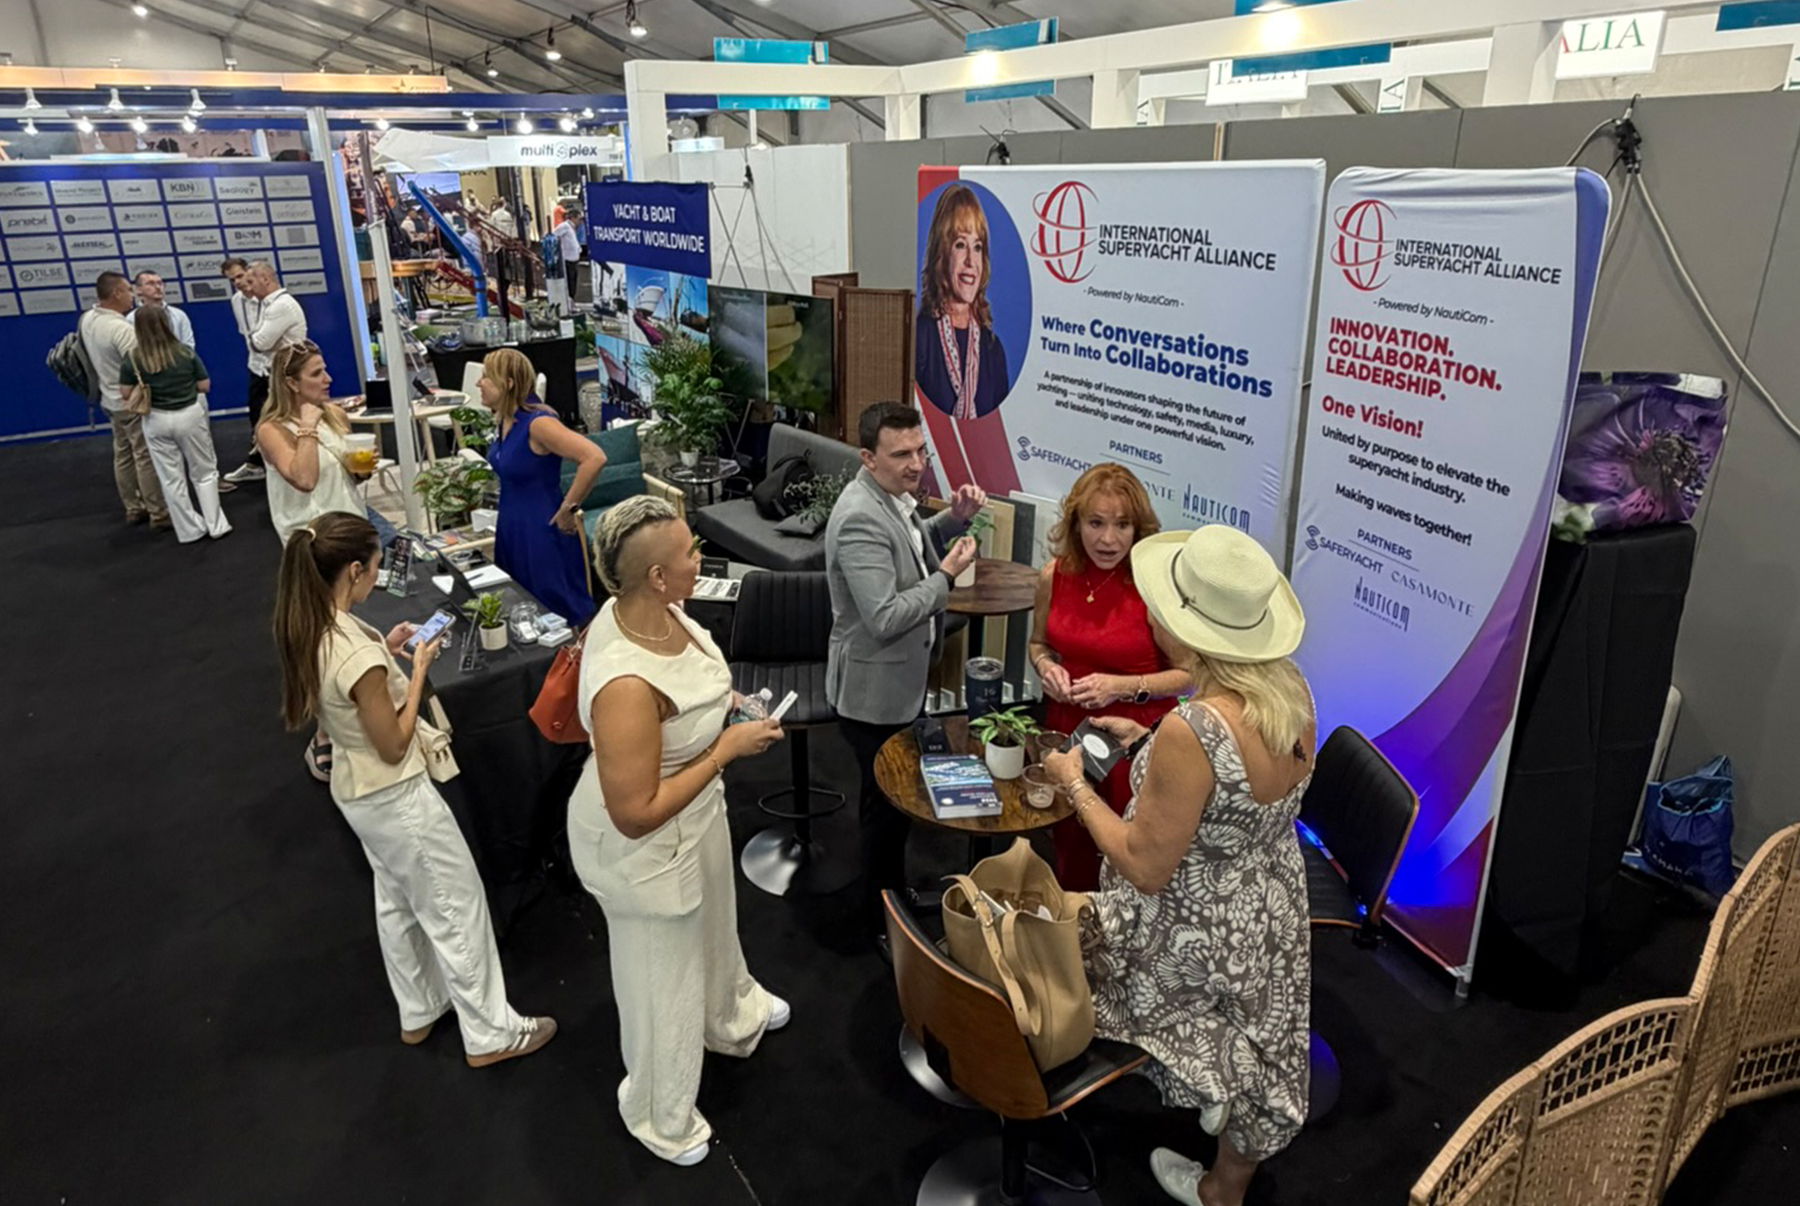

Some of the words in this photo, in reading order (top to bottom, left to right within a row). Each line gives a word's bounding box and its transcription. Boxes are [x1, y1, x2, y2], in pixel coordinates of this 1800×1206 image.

[520, 144, 554, 157] multi
[568, 145, 598, 159] plex
[612, 204, 641, 220] YACHT
[642, 205, 649, 221] &
[650, 206, 676, 223] BOAT
[593, 226, 642, 244] TRANSPORT
[642, 230, 705, 253] WORLDWIDE
[1098, 240, 1191, 263] SUPERYACHT
[1194, 247, 1276, 271] ALLIANCE
[1099, 224, 1212, 246] INTERNATIONAL
[1395, 238, 1502, 262] INTERNATIONAL
[1394, 253, 1481, 275] SUPERYACHT
[1484, 262, 1562, 285] ALLIANCE
[1087, 286, 1122, 300] Powered
[1123, 291, 1135, 303] by
[1135, 292, 1179, 308] NautiCom
[1377, 297, 1420, 313] Powered
[1420, 302, 1432, 318] by
[1433, 306, 1487, 325] NautiCom
[1041, 315, 1086, 336] Where
[1089, 319, 1250, 366] Conversations
[1330, 317, 1454, 357] INNOVATION.
[1040, 336, 1070, 355] Turn
[1074, 342, 1101, 361] Into
[1105, 344, 1273, 398] Collaborations
[1325, 356, 1446, 401] LEADERSHIP.
[1328, 337, 1502, 391] COLLABORATION.
[1037, 381, 1068, 398] yachting
[1077, 391, 1105, 407] uniting
[1106, 397, 1153, 419] technology,
[1155, 409, 1185, 428] safety,
[1186, 418, 1218, 435] media,
[1220, 426, 1255, 446] luxury,
[1044, 371, 1051, 379] A
[1051, 372, 1094, 392] partnership
[1094, 382, 1103, 391] of
[1103, 383, 1146, 402] innovators
[1148, 393, 1184, 413] shaping
[1185, 401, 1201, 413] the
[1202, 405, 1234, 424] future
[1235, 415, 1247, 427] of
[1322, 396, 1355, 419] One
[1359, 404, 1424, 438] Vision!
[1054, 398, 1069, 409] and
[1070, 401, 1109, 421] leadership
[1110, 411, 1134, 426] under
[1135, 418, 1152, 430] one
[1153, 422, 1194, 444] powerful
[1195, 434, 1226, 451] vision.
[1109, 440, 1163, 464] PARTNERS
[1322, 425, 1355, 446] United
[1357, 436, 1370, 453] by
[1371, 441, 1419, 467] purpose
[1421, 456, 1433, 471] to
[1436, 461, 1483, 487] elevate
[1486, 478, 1511, 497] the
[1348, 453, 1410, 484] superyacht
[1411, 471, 1466, 504] industry.
[1335, 483, 1374, 510] Making
[1376, 498, 1411, 522] waves
[1413, 512, 1473, 546] together!
[1357, 528, 1413, 561] PARTNERS
[1319, 537, 1384, 574] SAFERYACHT
[1391, 570, 1475, 618] CASAMONTE
[1354, 576, 1411, 633] NAUTICOM
